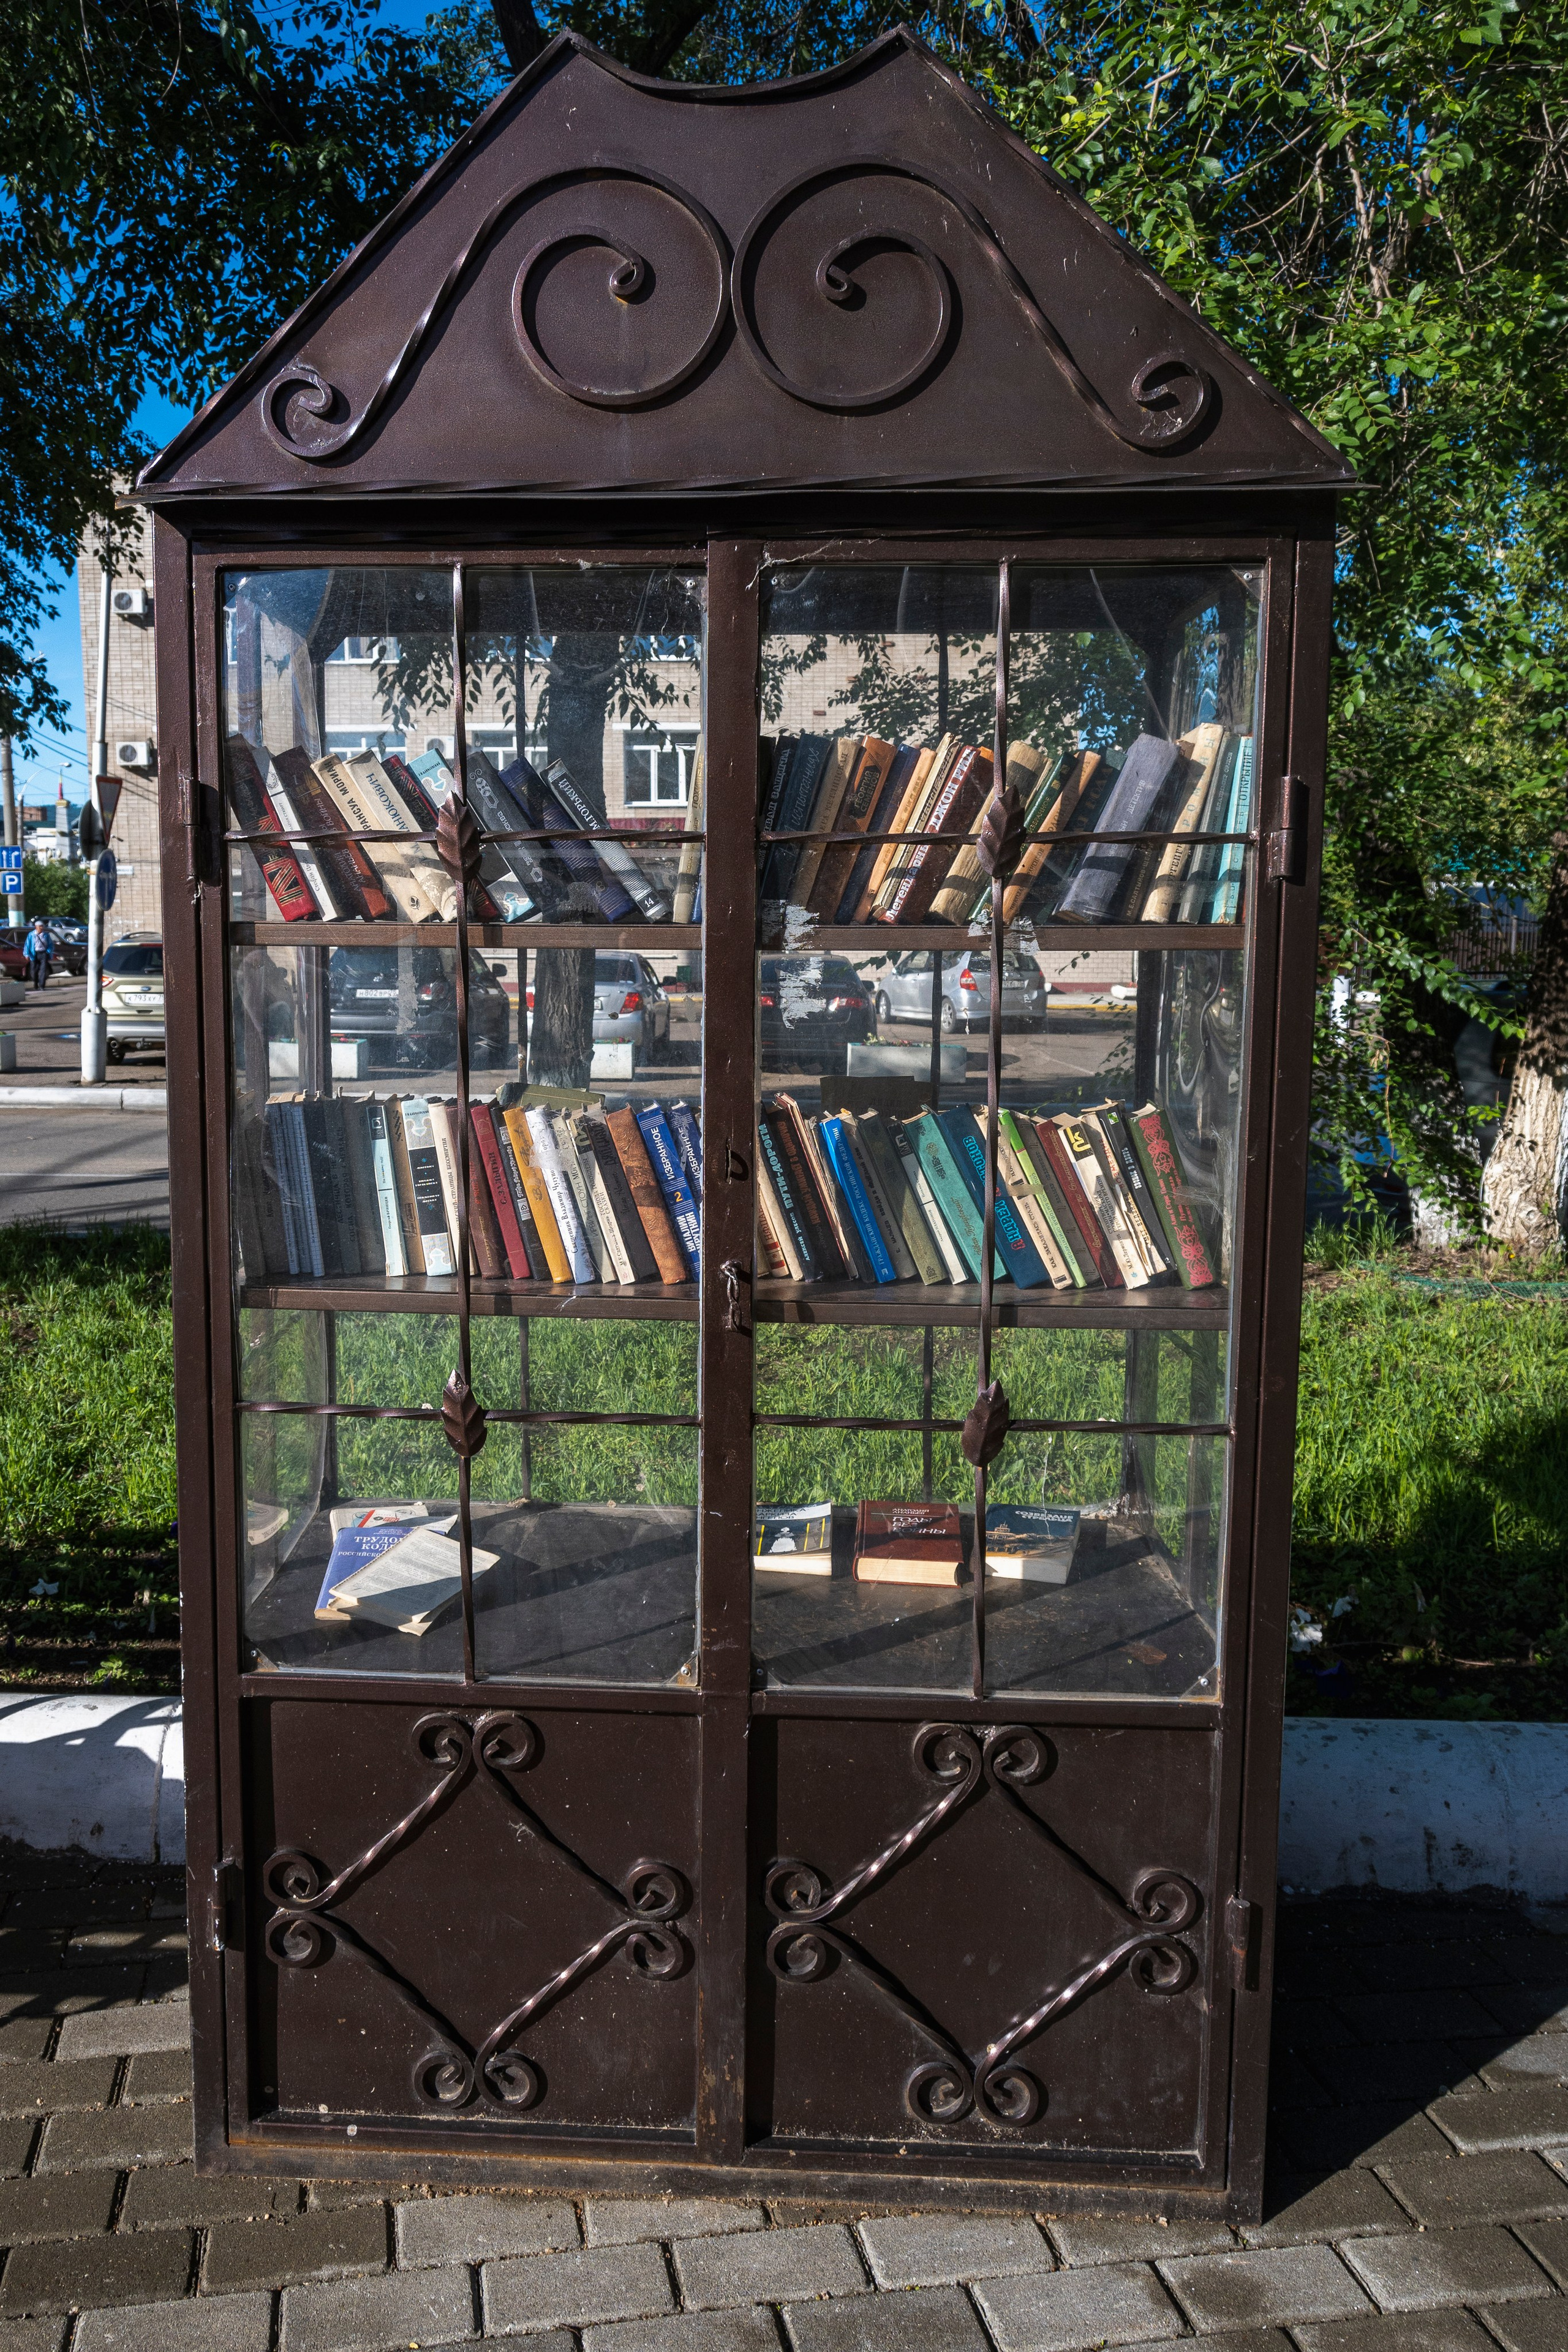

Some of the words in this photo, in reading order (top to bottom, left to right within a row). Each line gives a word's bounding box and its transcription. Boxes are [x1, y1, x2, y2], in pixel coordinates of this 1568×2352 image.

[770, 747, 791, 800] ЗАЩИТА
[1223, 751, 1233, 772] ОРЛОВ
[1238, 752, 1253, 801] ОТКРЫТИЕ
[824, 752, 848, 811] КЕТЛИНСКАЯ
[852, 770, 873, 808] ГЕОРГИЙ
[859, 771, 880, 812] СЕМЕНОВ
[929, 780, 959, 831] ДЖОН
[952, 747, 976, 782] РИД
[1126, 778, 1146, 814] ДЕТЕКТИВ
[314, 796, 334, 826] ВОЙНЫ
[365, 771, 410, 834] АНЮКОВИЧ
[557, 777, 601, 831] М.ГОРЬКИЙ
[1027, 796, 1052, 833] ИЗБРАННОЕ
[341, 847, 366, 884] АНАНЬЕВ
[1126, 842, 1156, 916] М.Е.САЛТЫКОВ-ЩЕДРИ
[6, 875, 18, 891] P
[307, 871, 321, 892] Стефан
[643, 896, 654, 908] 14
[441, 1137, 451, 1169] БЕССМЕРТИЯ
[650, 1126, 675, 1179] ИЗБРАННОЕ
[832, 1126, 849, 1161] ФЕДЕРАЦИИ
[854, 1145, 864, 1161] ДОМ
[1120, 1147, 1133, 1164] ДВЕРЬ
[488, 1151, 508, 1205] С.ЗАЛЫГИН
[546, 1167, 561, 1191] Чугуно
[758, 1123, 794, 1209] ПУТИ-ДОРОГИ
[843, 1161, 861, 1199] РОССИЙСКОЙ
[1129, 1170, 1142, 1189] ЗВОНОК
[447, 1171, 457, 1199] СТРАНИЦЫ
[574, 1182, 589, 1208] СТОУН
[674, 1191, 682, 1202] 2
[1095, 1175, 1108, 1196] ВРЕМЕНИ
[553, 1190, 570, 1220] Владимир
[598, 1191, 611, 1215] СКАЗКИ
[856, 1199, 870, 1223] КОДЕКС
[873, 1194, 886, 1216] ВОЙДИ
[1023, 1201, 1036, 1221] СТАЛЬ
[1093, 1196, 1113, 1234] СТИХОТВОРЕНИЯ
[1104, 1196, 1116, 1216] НАШЕГО
[1163, 1194, 1173, 1210] Серж
[583, 1208, 598, 1237] ИРВИНГ
[789, 1211, 802, 1234] УЛЕСОВ
[883, 1219, 897, 1243] МАЛЬЦЕВ
[992, 1199, 1026, 1251] АНДРЕЙ
[1168, 1214, 1177, 1226] Анн
[563, 1220, 579, 1254] Священник
[797, 1235, 810, 1261] АЛЕКСЕЙ
[864, 1222, 885, 1265] ГРАЖДАНСКИЙ
[1032, 1220, 1051, 1255] ЗАКАЛЯЛАСЬ
[1055, 1226, 1076, 1265] ОРИЕНТИРОВКА
[1048, 1256, 1057, 1268] КАК
[1015, 1510, 1074, 1519] СОЗВЕЗДИЕ
